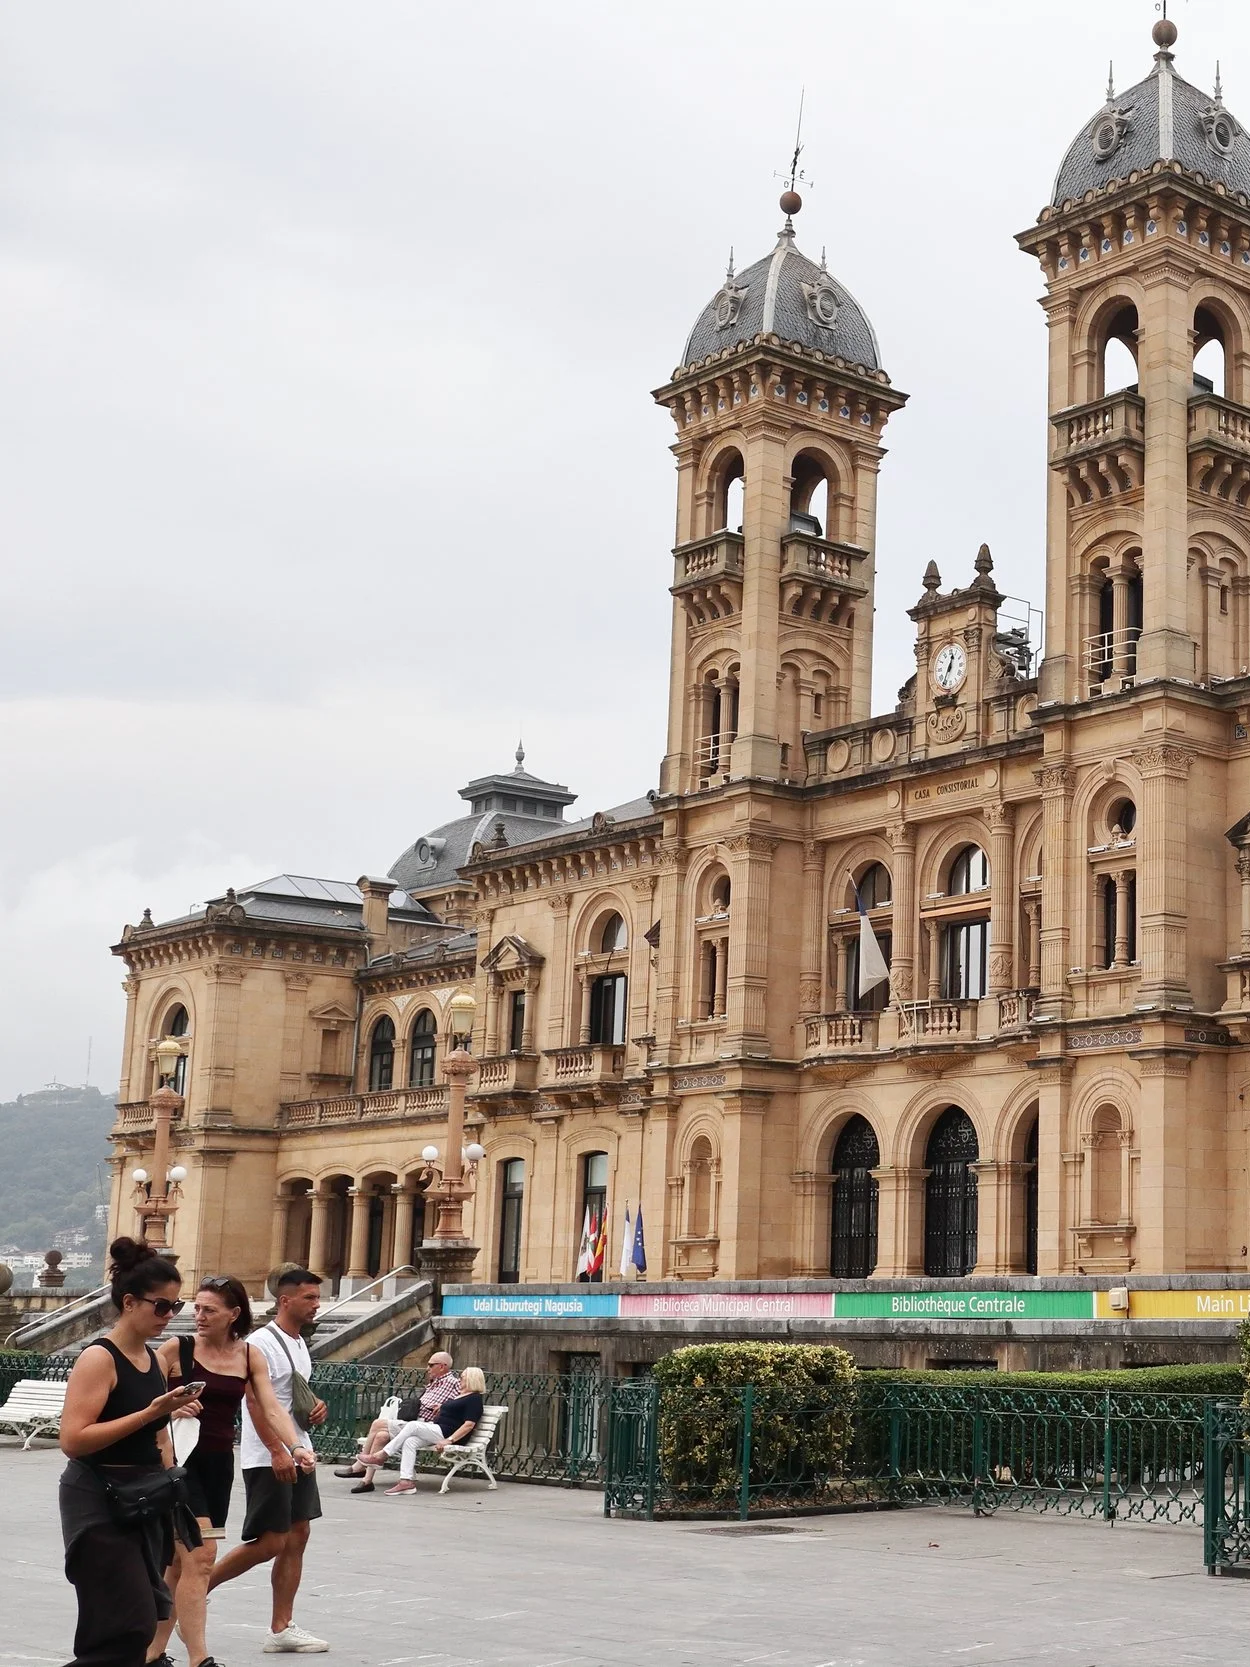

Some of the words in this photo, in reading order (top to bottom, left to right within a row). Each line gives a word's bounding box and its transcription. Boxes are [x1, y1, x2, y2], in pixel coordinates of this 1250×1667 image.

[914, 789, 930, 800] CASA
[936, 778, 979, 795] CONSISTORIAL
[473, 1299, 493, 1312] Udal
[495, 1298, 542, 1315] Liburutegi
[544, 1298, 583, 1315] Nagusia
[653, 1297, 699, 1312] Biblioteca
[702, 1297, 753, 1316] Municipal
[756, 1297, 794, 1312] Central
[892, 1296, 966, 1316] Bibliothèque
[969, 1296, 1025, 1312] Centrale
[1197, 1295, 1234, 1312] Main
